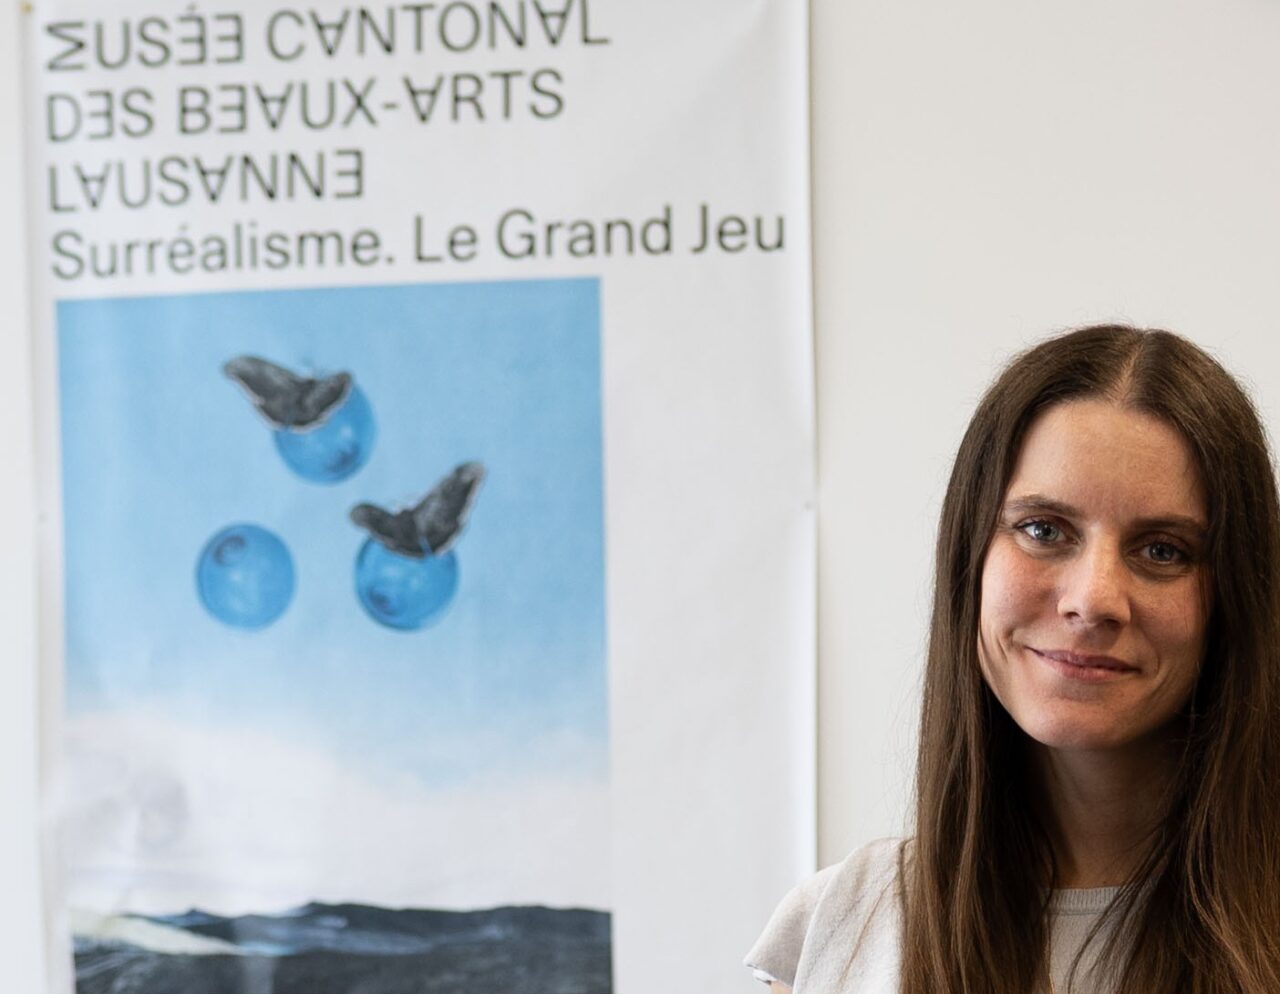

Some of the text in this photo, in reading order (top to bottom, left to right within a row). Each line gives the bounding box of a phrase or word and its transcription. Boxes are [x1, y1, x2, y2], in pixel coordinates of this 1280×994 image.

[47, 68, 565, 143] DES BEAUX-ARTS
[49, 149, 365, 213] LAUSANNE
[51, 204, 785, 280] Surréalisme. Le Grand Jeu
